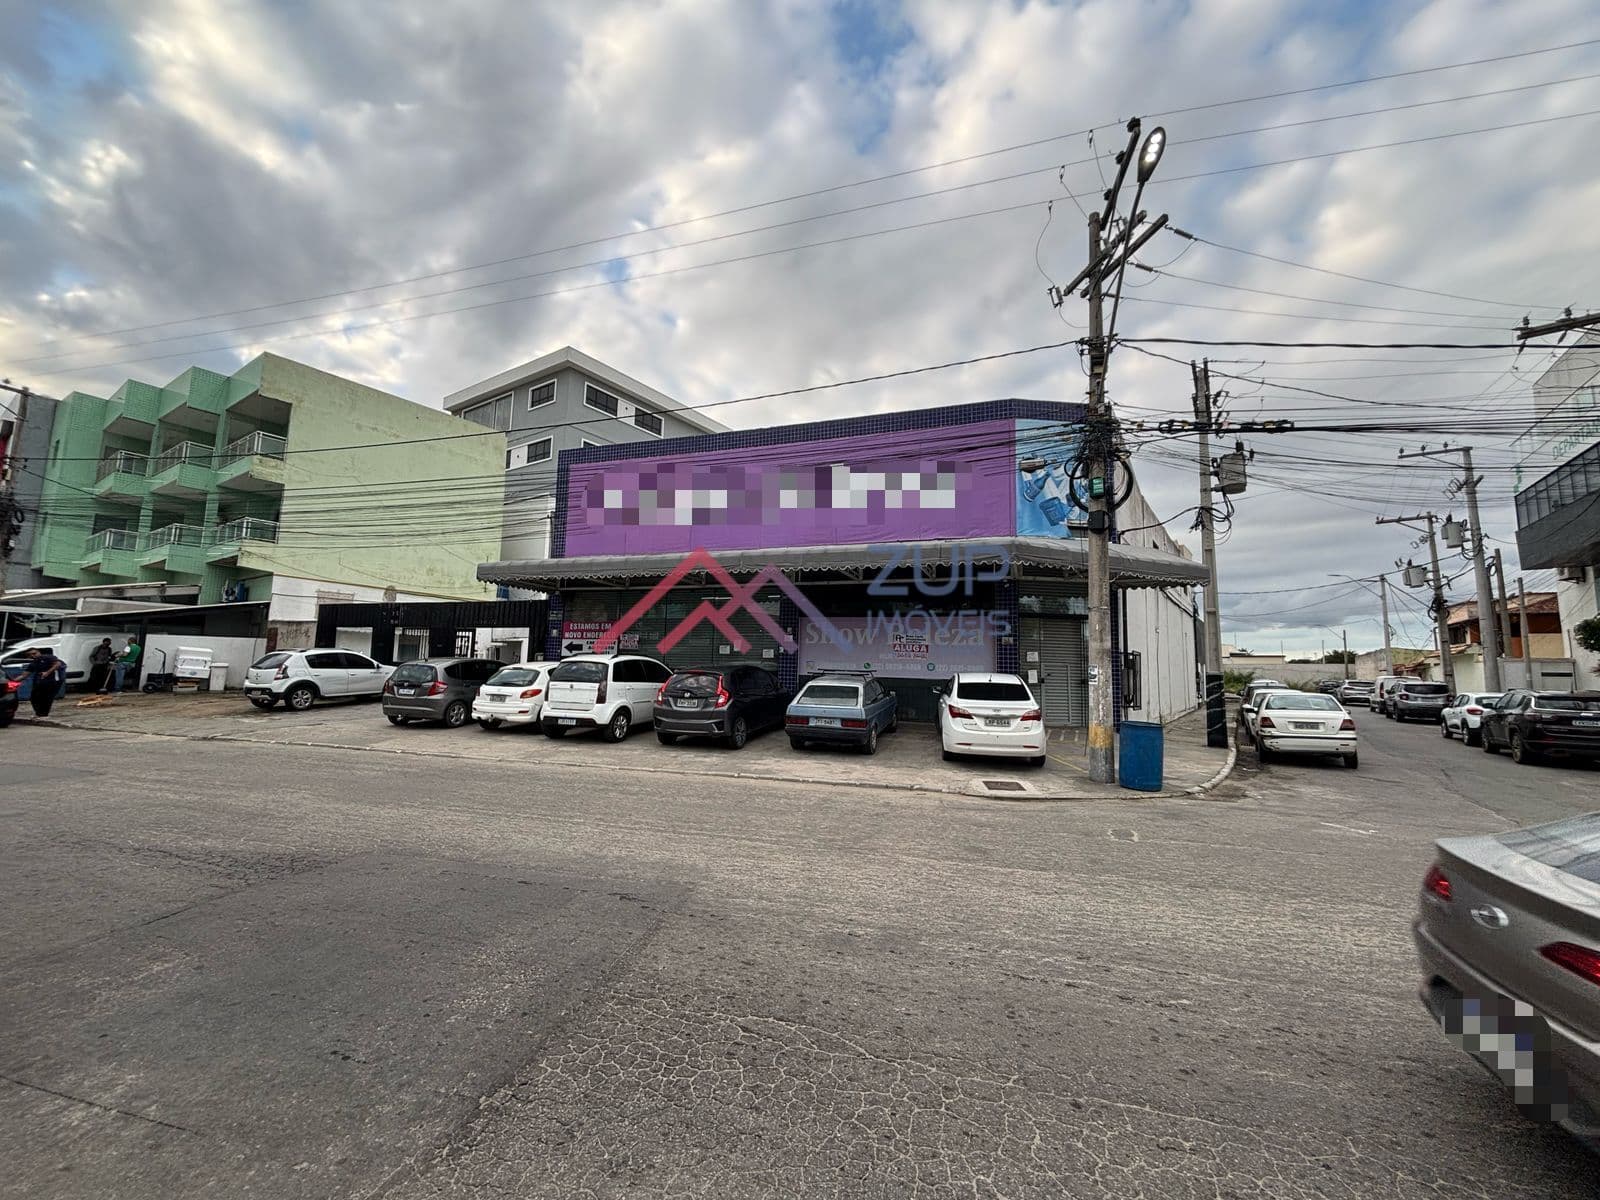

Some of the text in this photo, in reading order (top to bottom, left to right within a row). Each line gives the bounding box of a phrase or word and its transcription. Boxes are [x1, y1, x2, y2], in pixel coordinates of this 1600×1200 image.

[569, 623, 600, 631] ESTAMOS
[564, 631, 582, 639] NOVO
[894, 644, 928, 652] ALUGA
